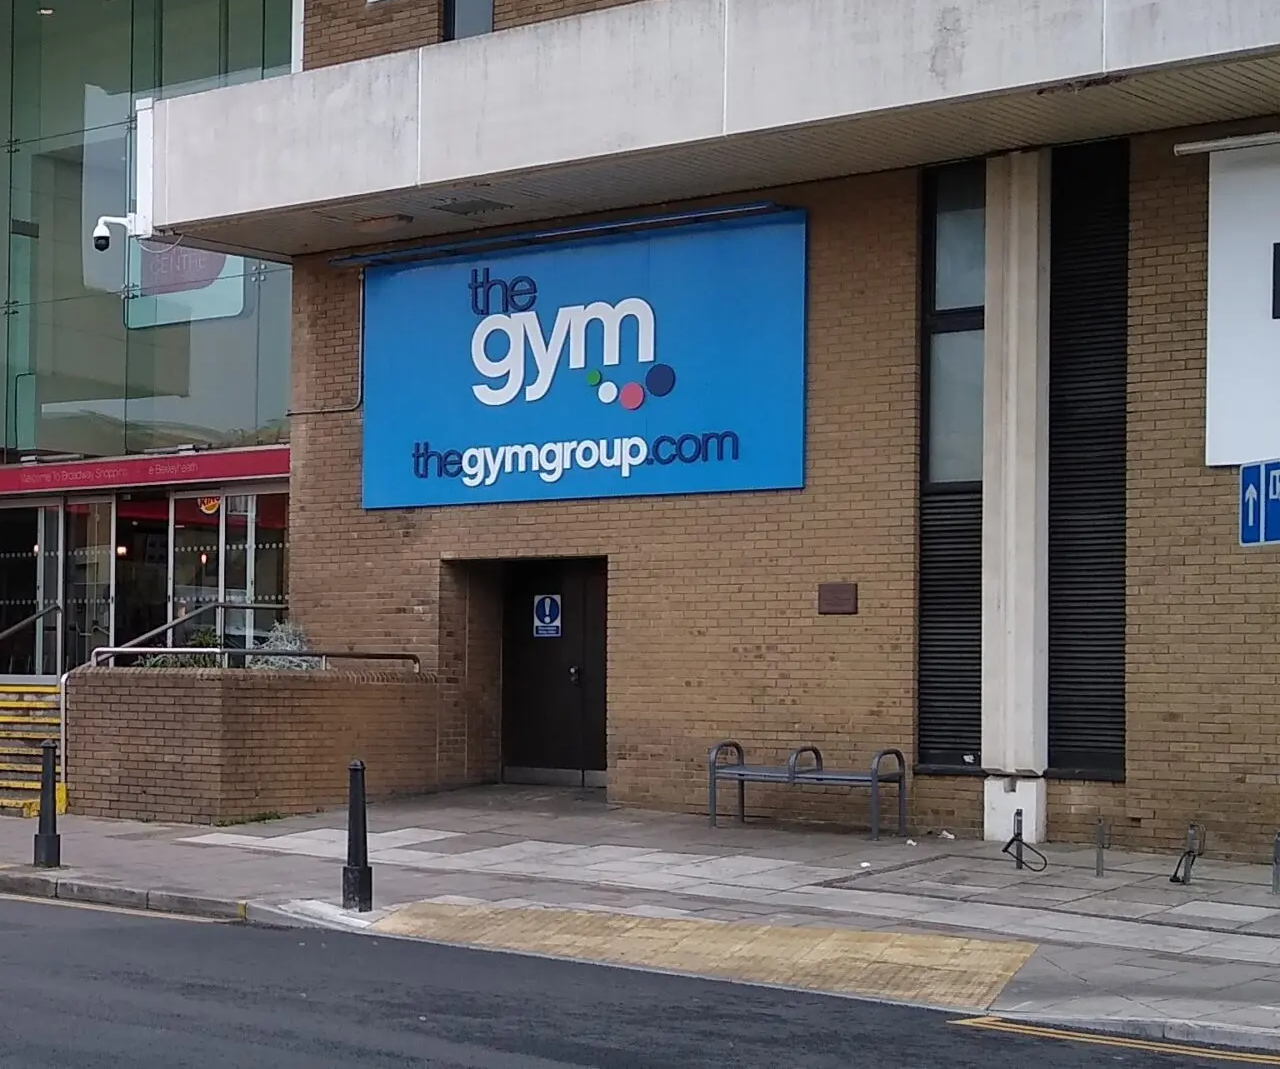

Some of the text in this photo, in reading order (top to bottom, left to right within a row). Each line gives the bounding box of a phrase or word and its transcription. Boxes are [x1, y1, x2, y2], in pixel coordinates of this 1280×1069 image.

[469, 268, 537, 315] the
[471, 297, 655, 406] gym
[61, 470, 95, 482] Broadway
[412, 431, 739, 487] thegymgroup.com
